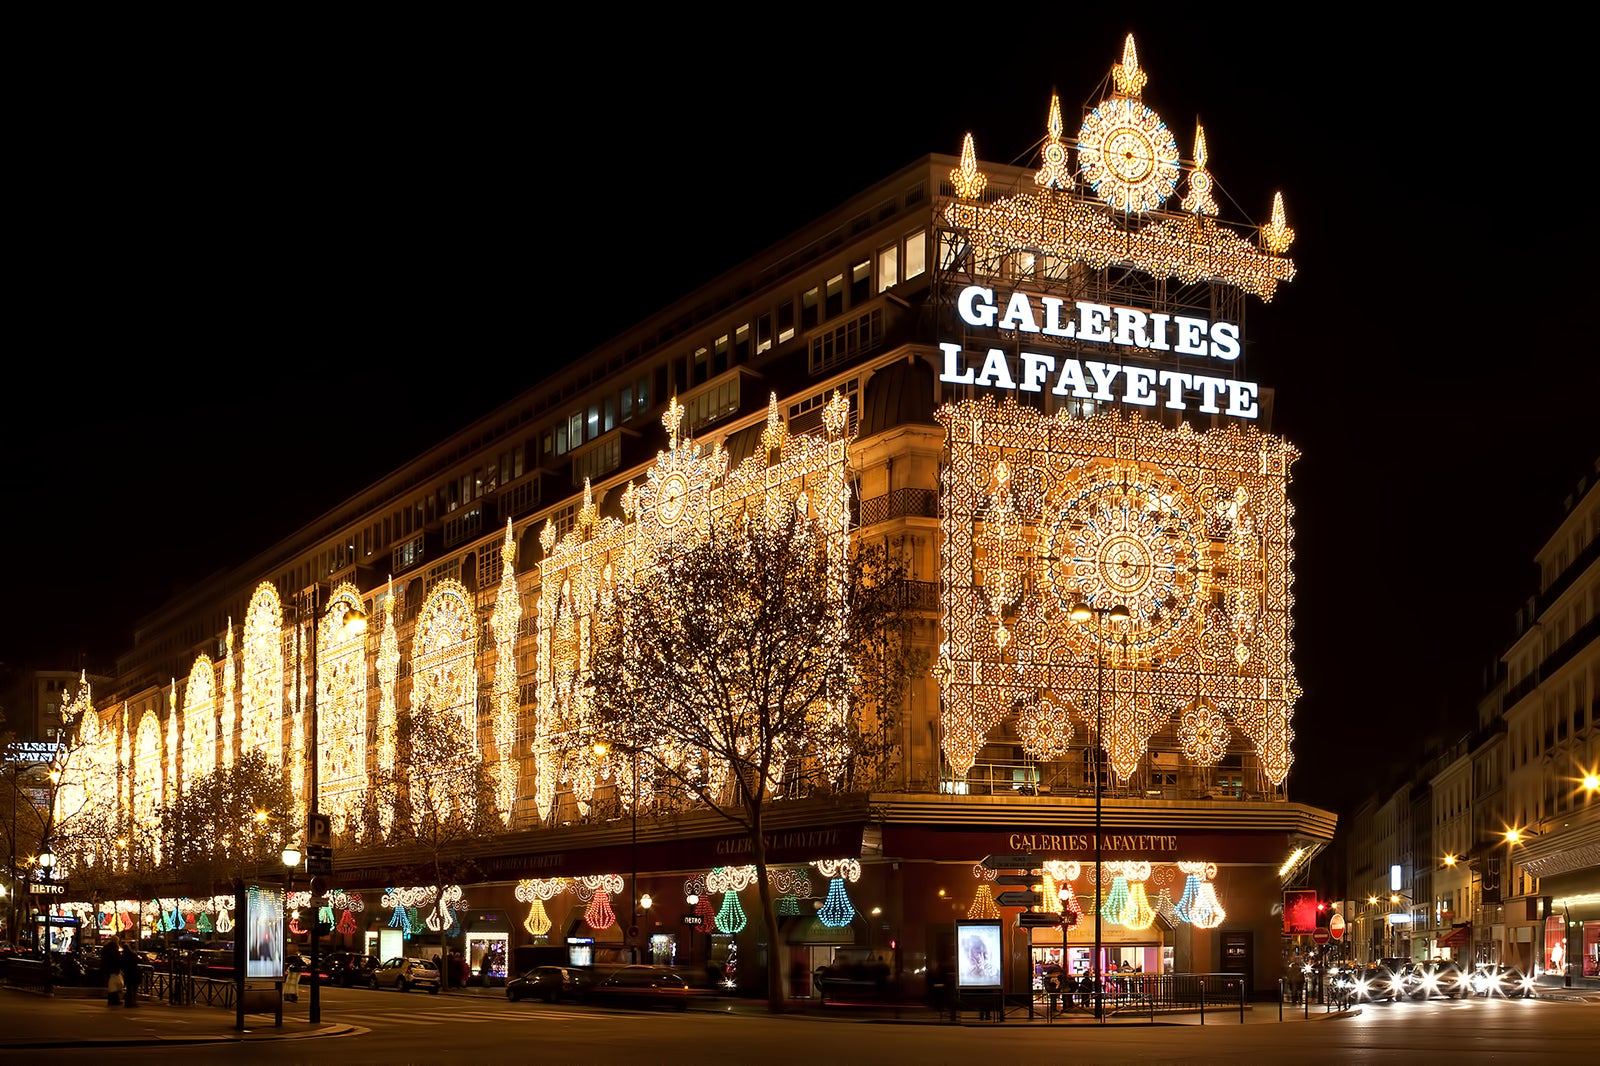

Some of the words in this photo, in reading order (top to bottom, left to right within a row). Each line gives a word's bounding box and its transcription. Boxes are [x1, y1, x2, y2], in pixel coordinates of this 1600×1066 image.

[957, 285, 1242, 361] GALERIES
[938, 342, 1259, 419] LAFAYETTE
[314, 819, 325, 838] P
[1009, 834, 1088, 851] GALERIES
[1093, 834, 1177, 851] LAFAYETTE
